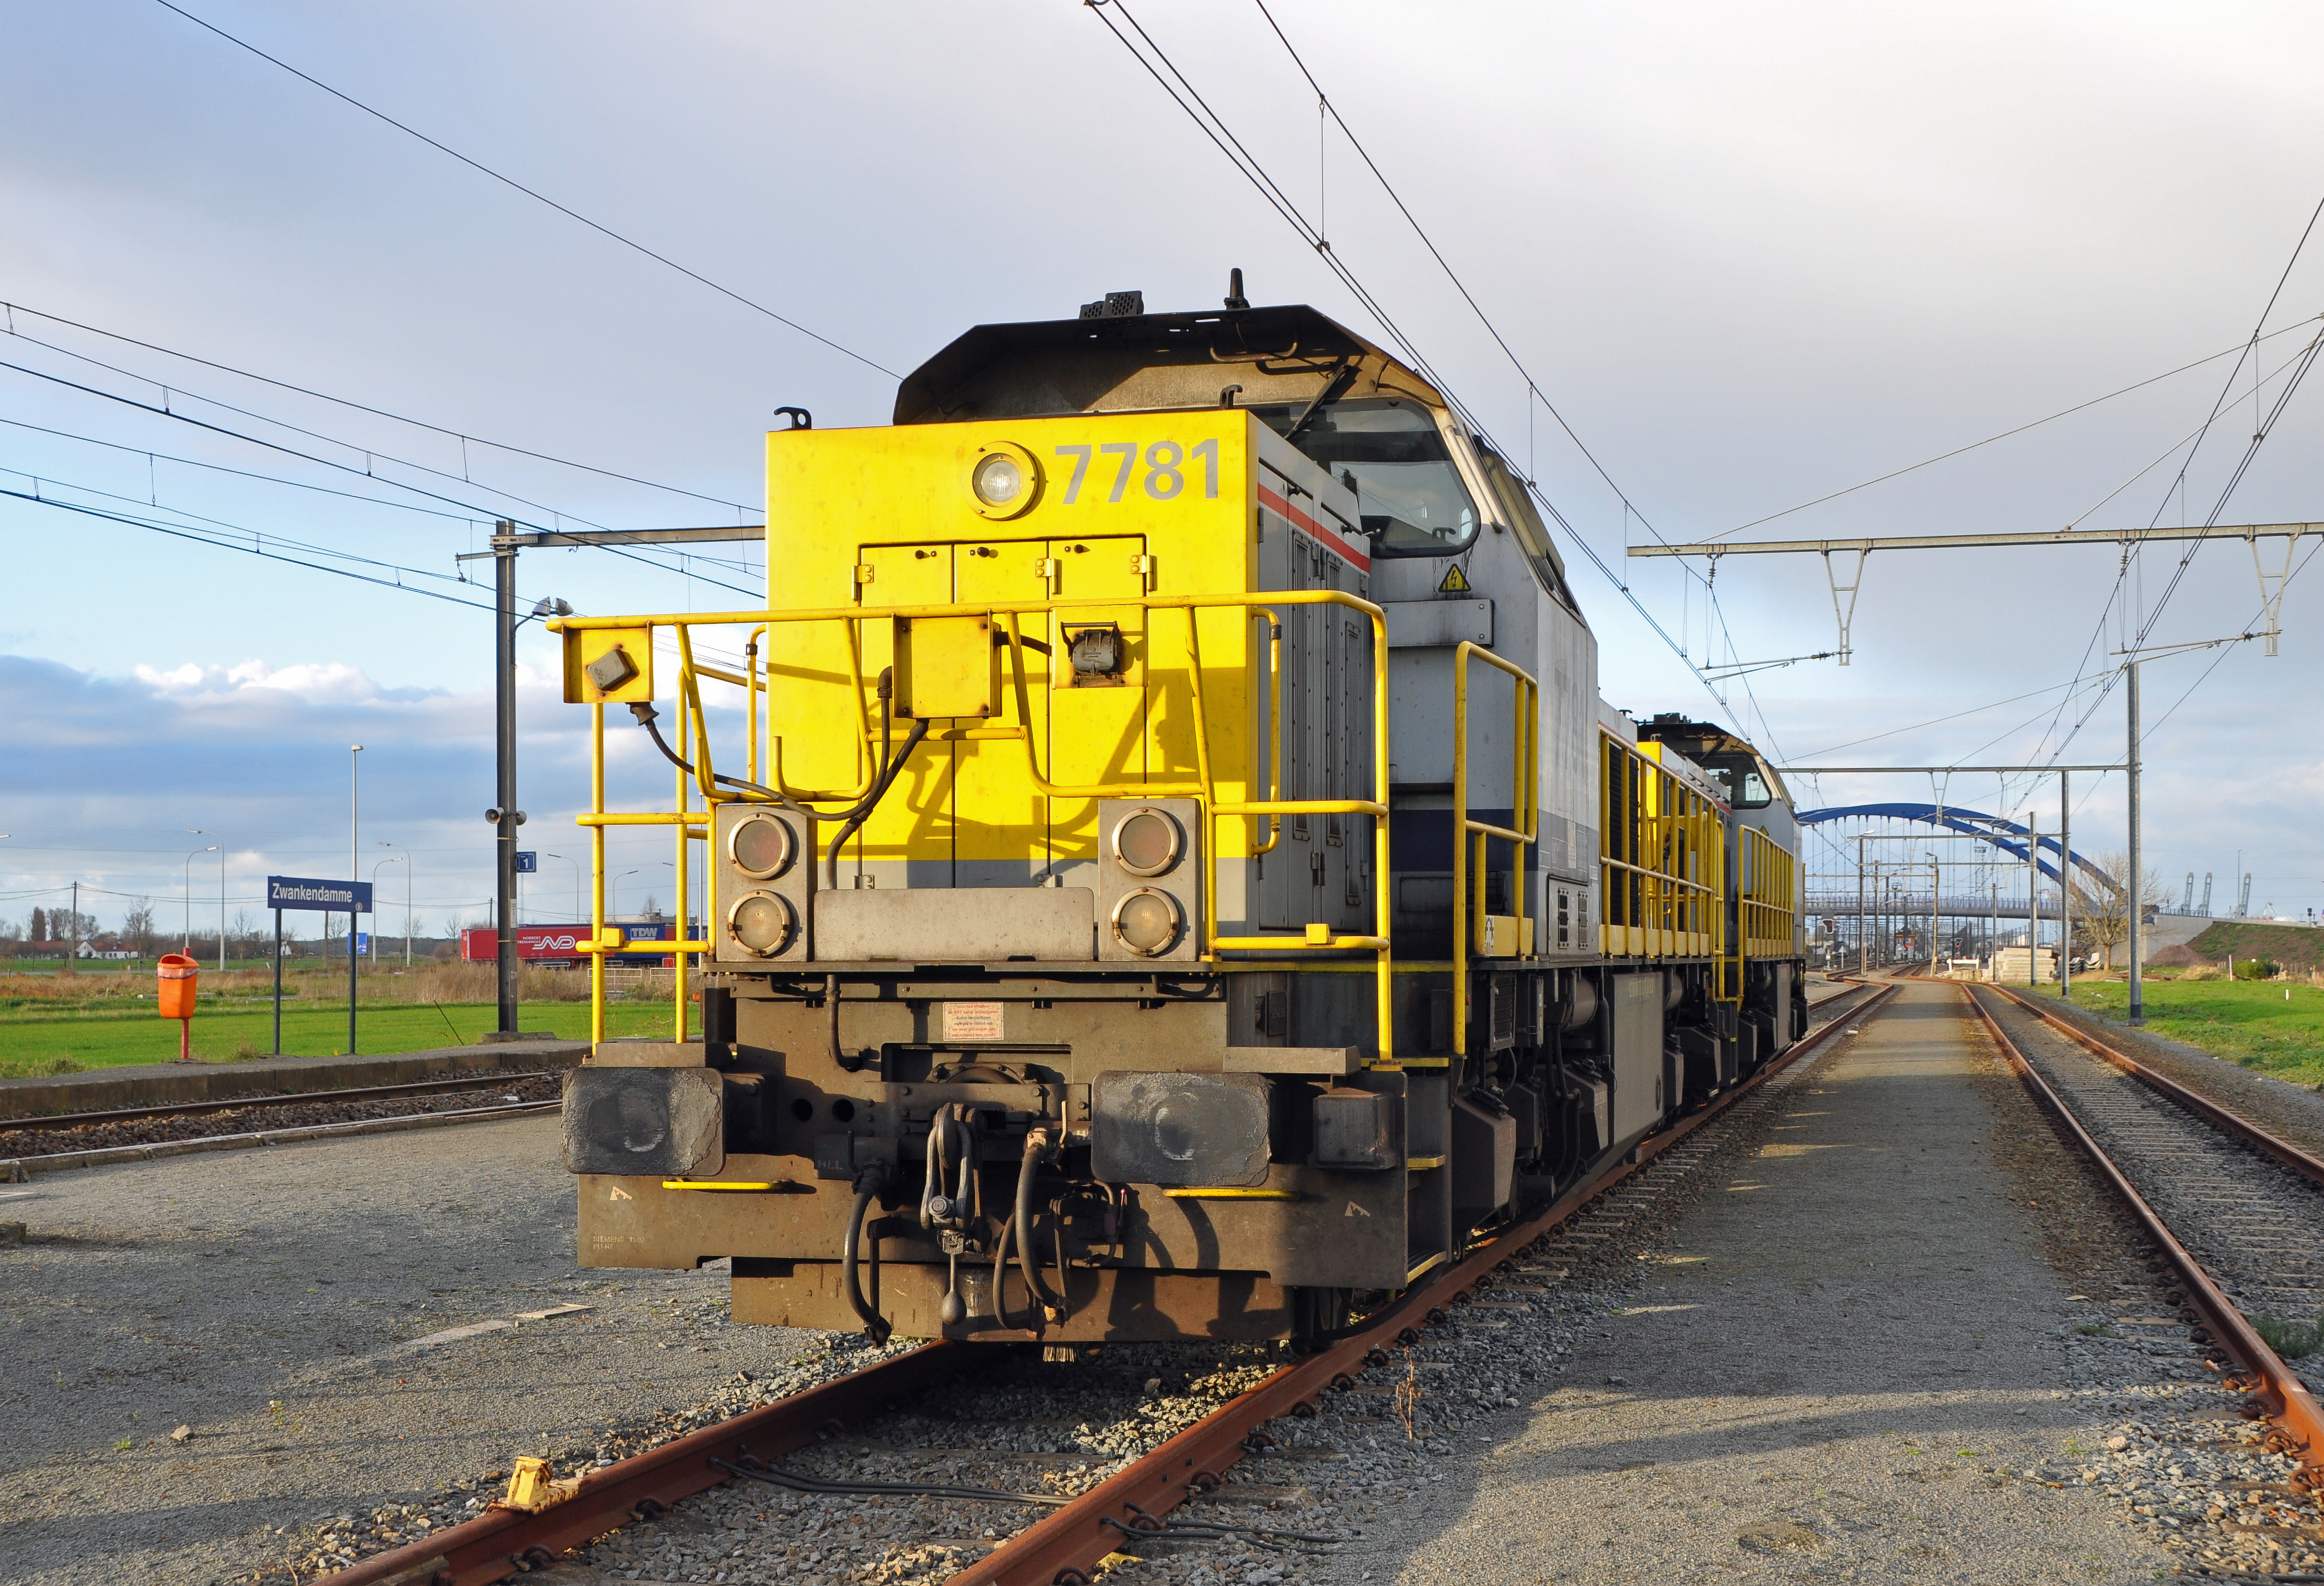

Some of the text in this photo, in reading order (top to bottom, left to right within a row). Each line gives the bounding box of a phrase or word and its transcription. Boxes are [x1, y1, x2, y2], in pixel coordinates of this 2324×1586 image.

[1055, 438, 1218, 505] 7781
[523, 858, 529, 868] 1
[272, 883, 353, 903] Zwankendamme
[631, 928, 657, 937] TDW
